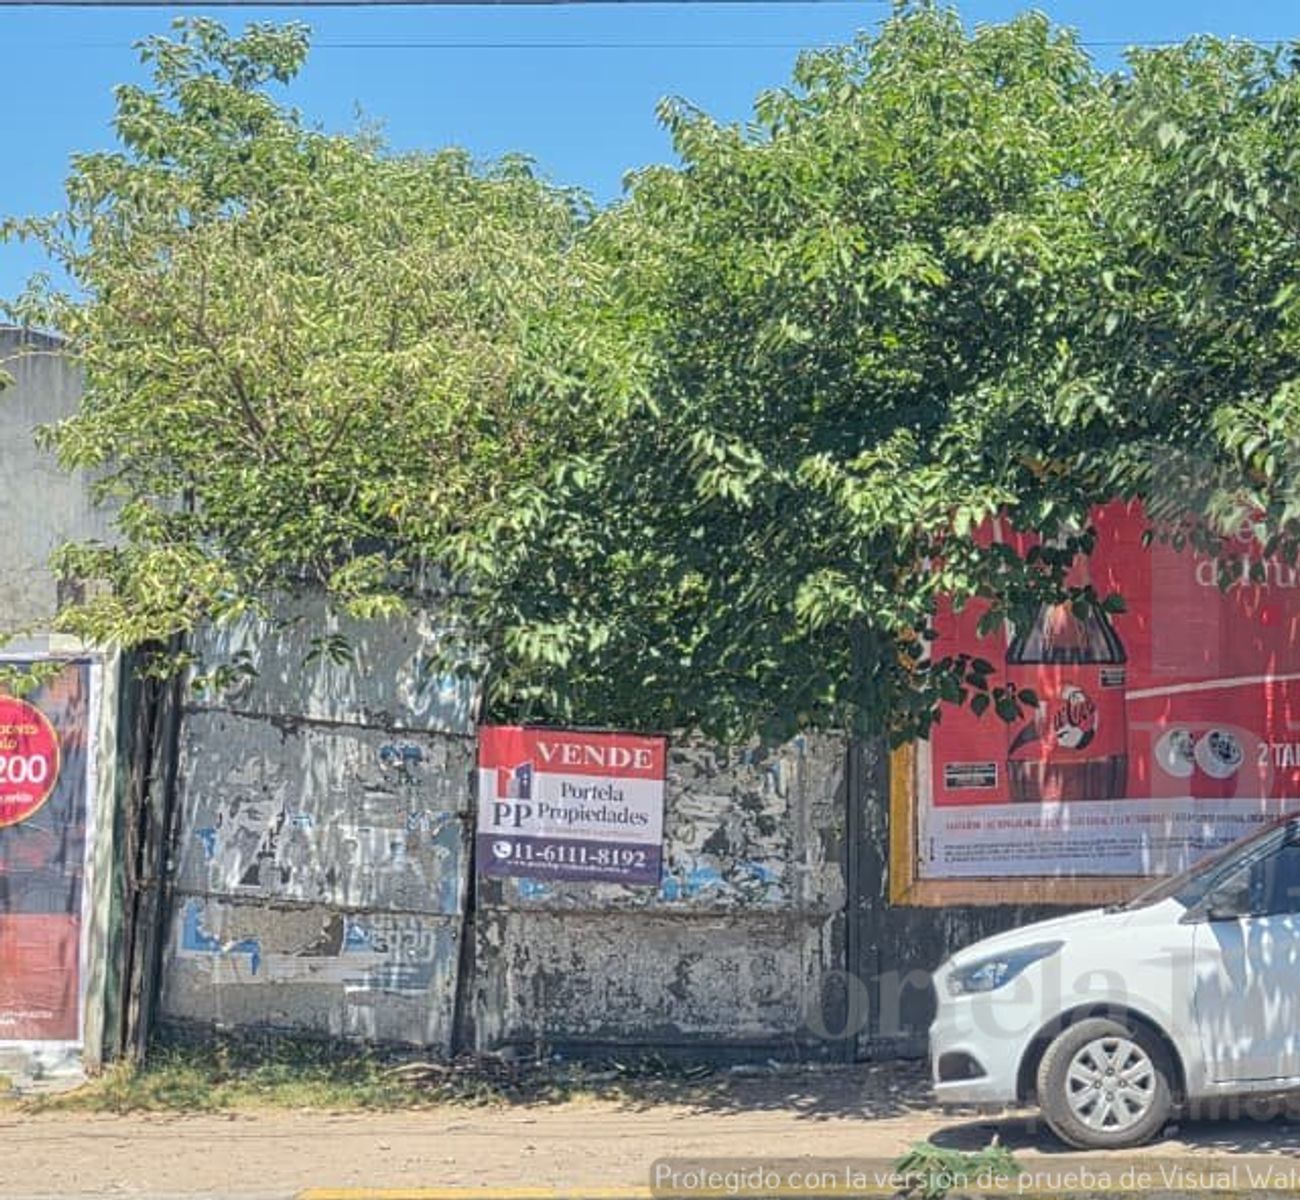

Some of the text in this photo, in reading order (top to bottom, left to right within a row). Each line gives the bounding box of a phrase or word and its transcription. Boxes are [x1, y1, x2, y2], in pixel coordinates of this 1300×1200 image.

[1195, 554, 1250, 587] dl
[536, 741, 653, 770] VENDE
[1257, 743, 1269, 767] 2
[561, 781, 625, 802] Portela
[537, 802, 649, 827] Propiedades
[514, 842, 647, 868] 11-6111-8192
